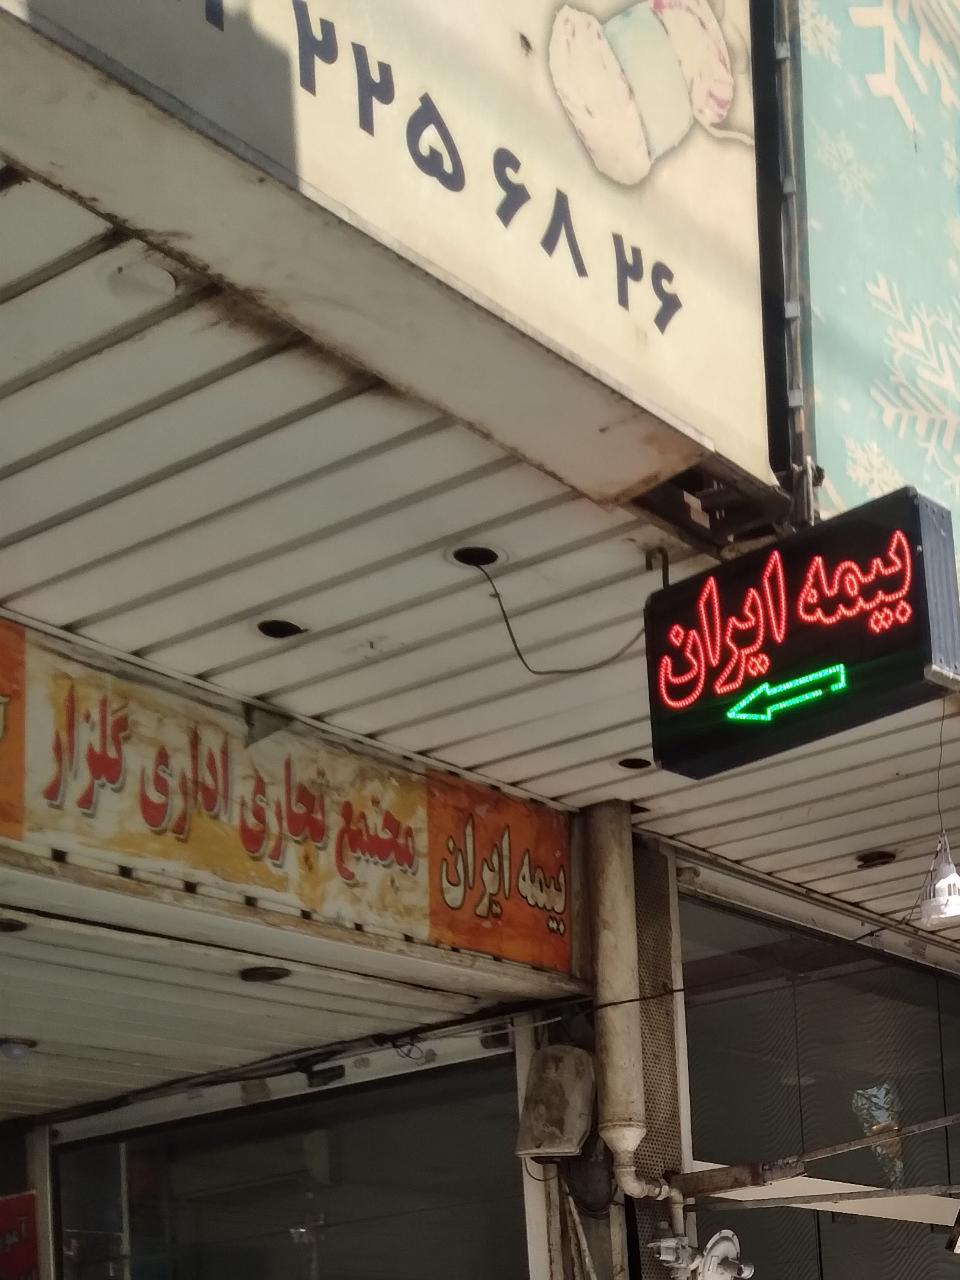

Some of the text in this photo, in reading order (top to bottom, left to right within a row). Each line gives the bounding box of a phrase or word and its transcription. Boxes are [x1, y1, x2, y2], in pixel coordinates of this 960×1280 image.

[203, 0, 683, 335] ۲۲۵۶۸۲۶
[659, 529, 912, 708] بیمه ایران
[41, 682, 131, 818] گلزار
[139, 725, 232, 842] اداری
[239, 752, 328, 868] تجاری
[334, 795, 418, 884] مجتمع
[440, 813, 567, 936] بیمه ایران
